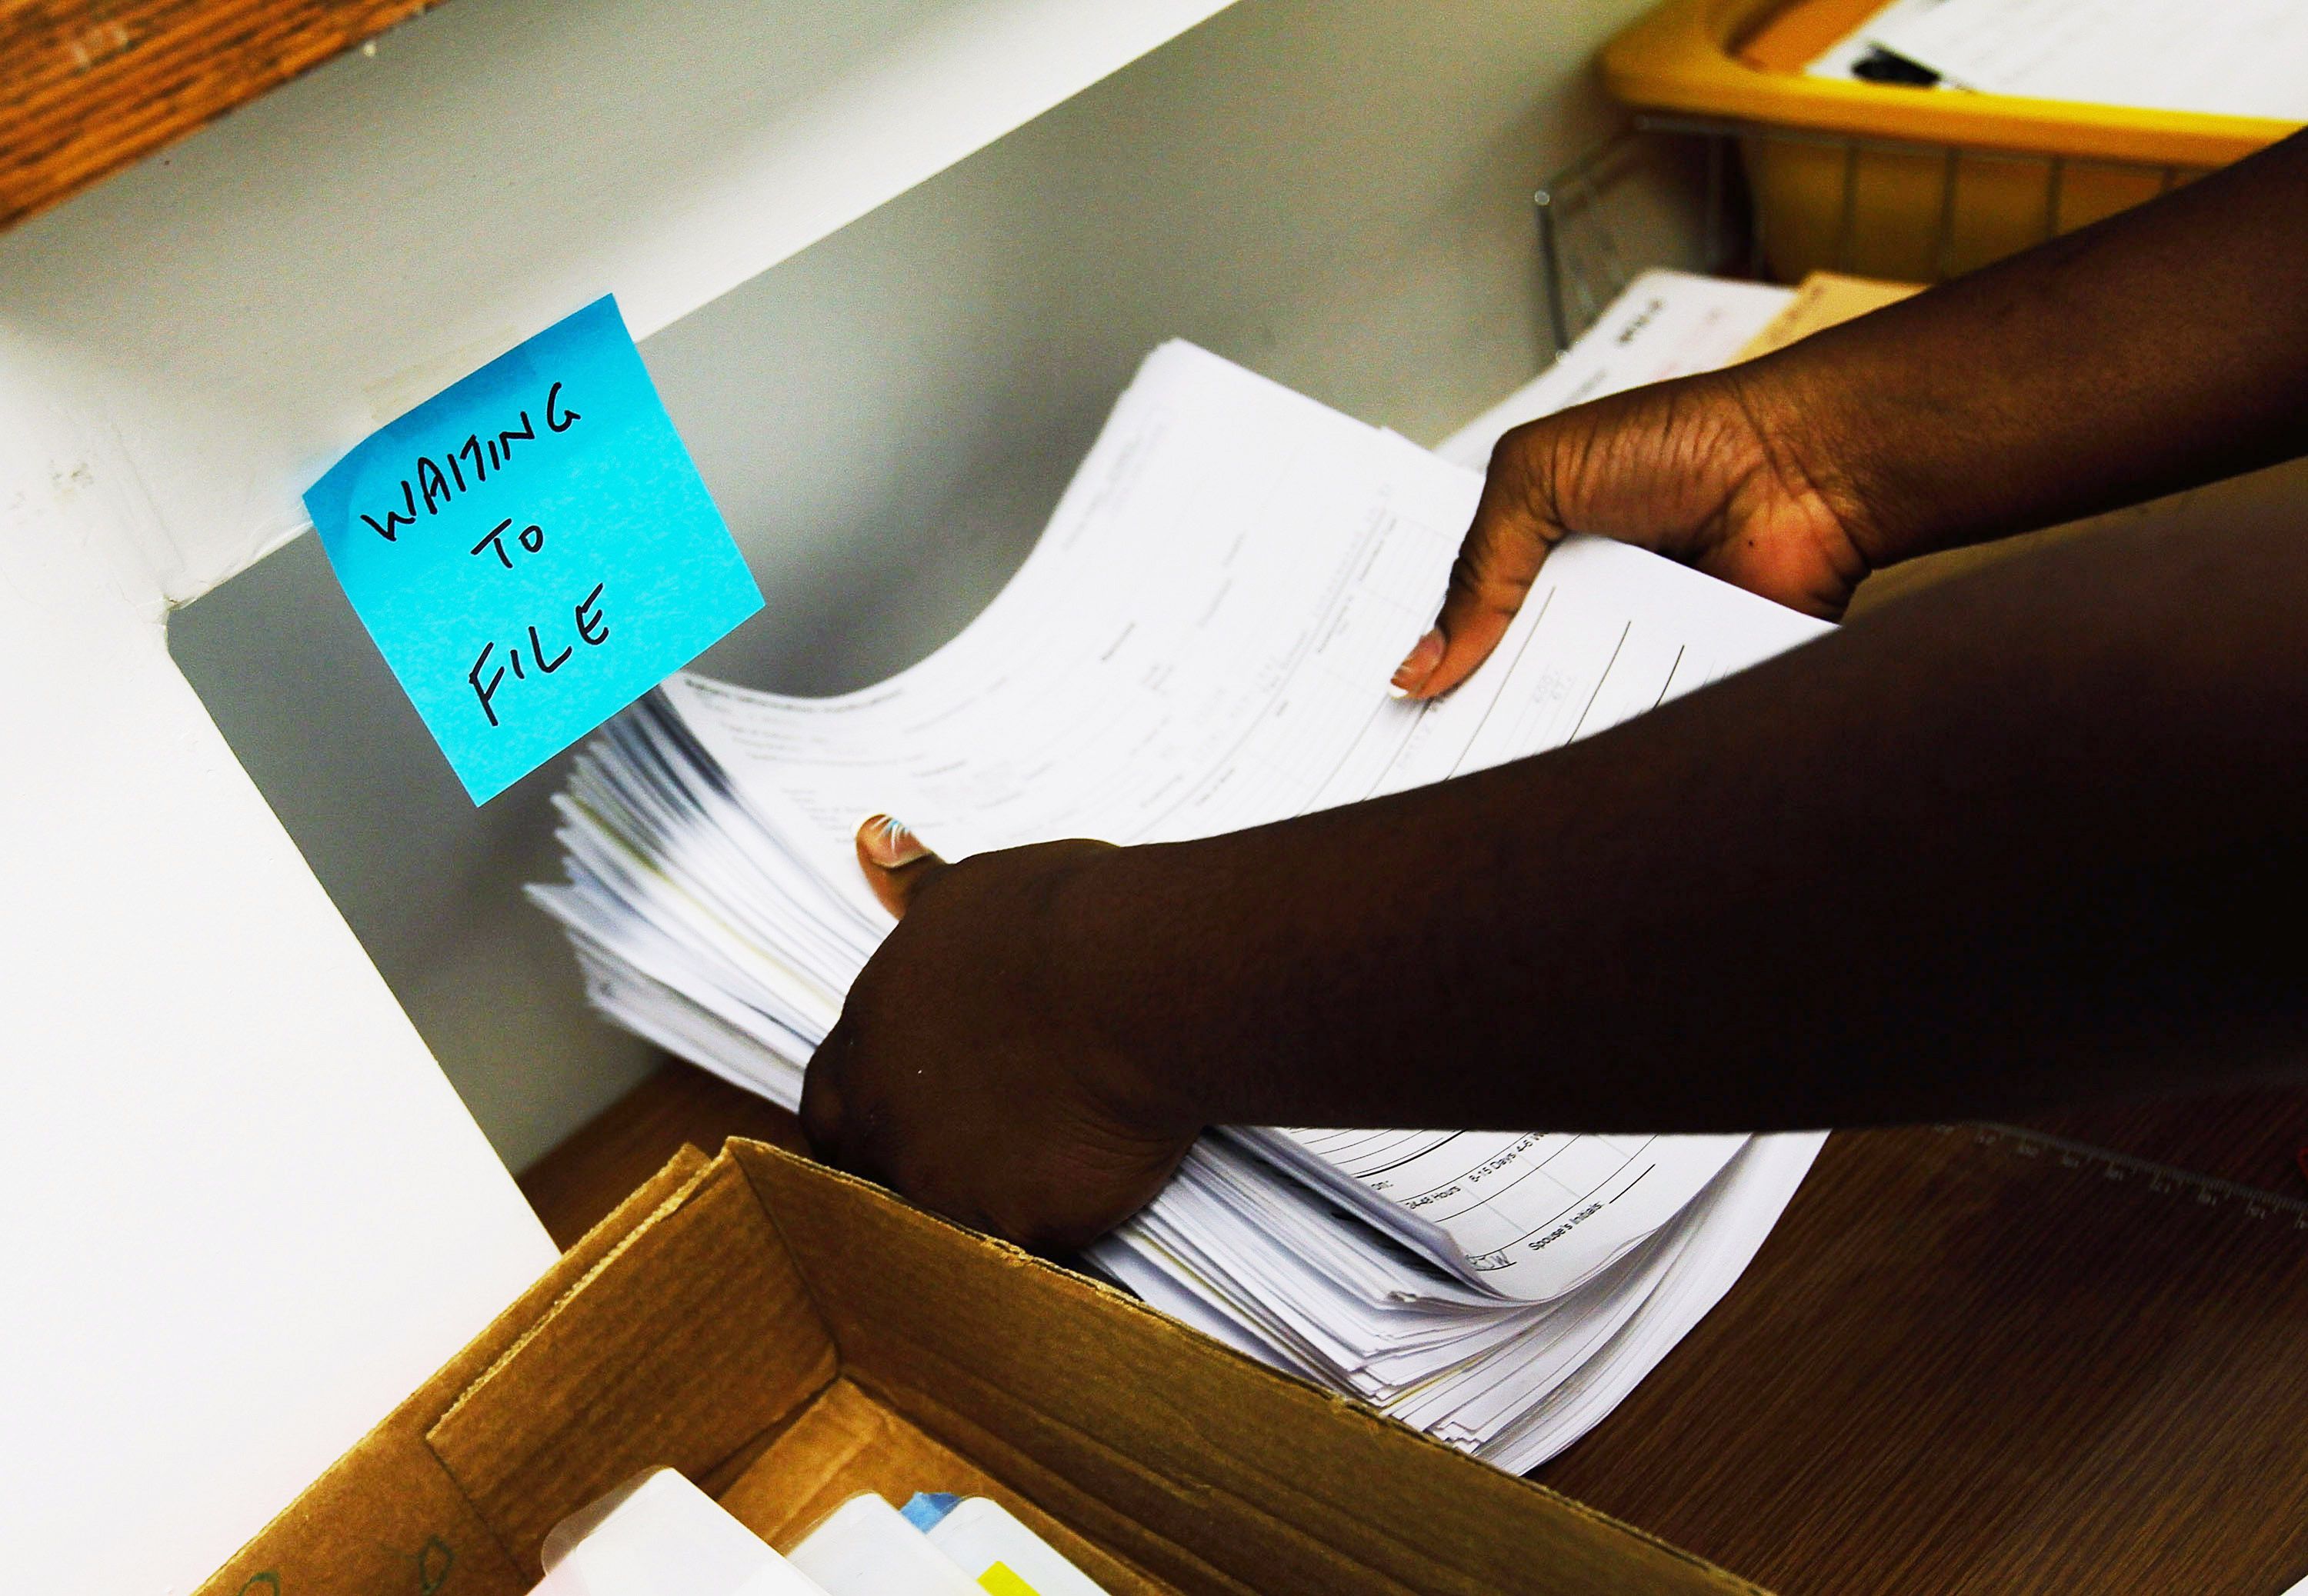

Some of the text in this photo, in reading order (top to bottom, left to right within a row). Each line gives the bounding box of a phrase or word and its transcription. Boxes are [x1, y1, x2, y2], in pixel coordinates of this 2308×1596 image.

[360, 382, 581, 541] WAITING
[470, 518, 544, 568] TO
[469, 582, 609, 726] FILE
[1490, 1152, 1516, 1169] Days
[1434, 1185, 1461, 1202] Hours
[1528, 1223, 1572, 1251] Spouse's
